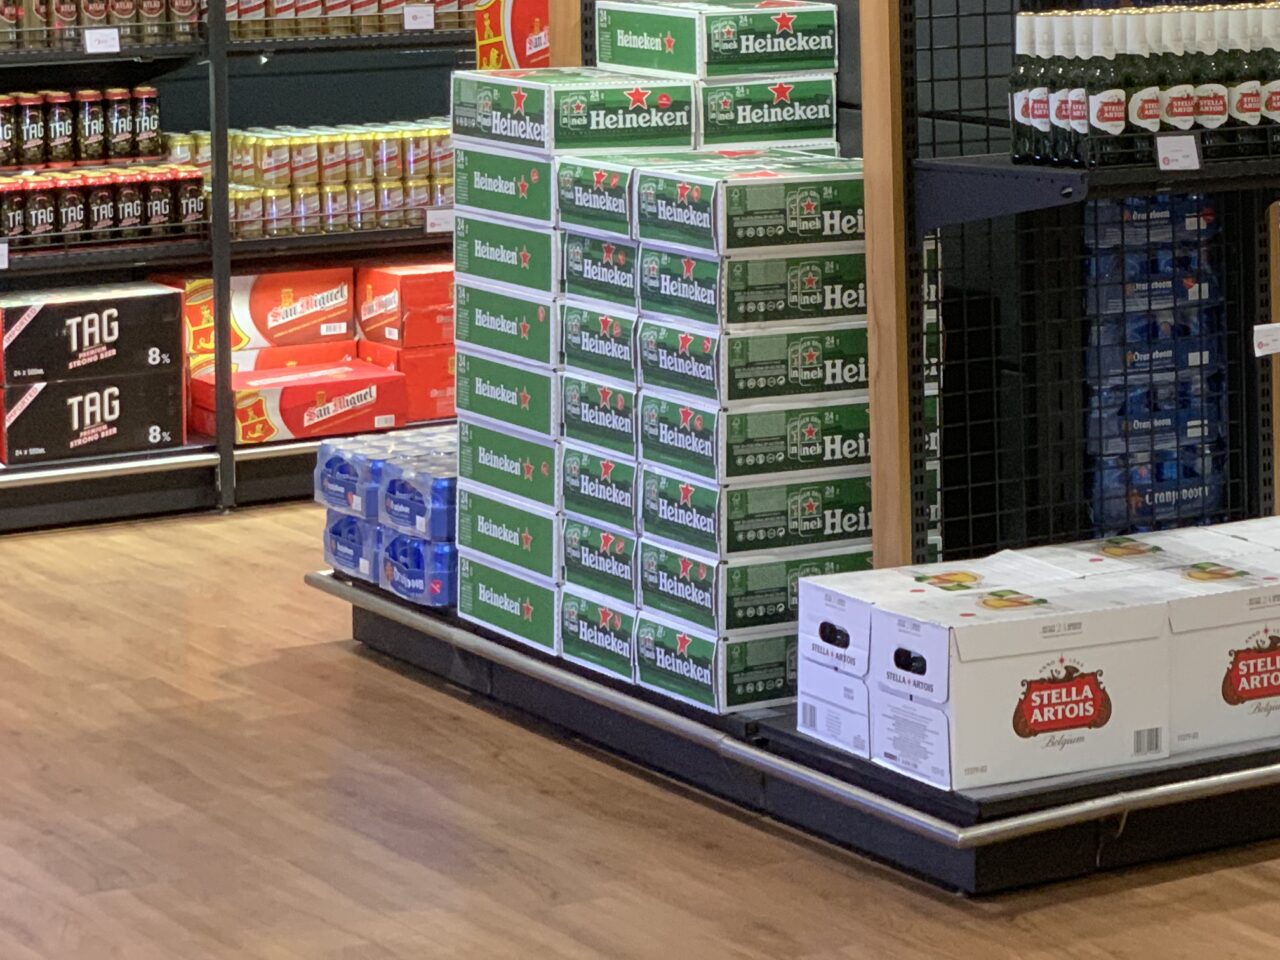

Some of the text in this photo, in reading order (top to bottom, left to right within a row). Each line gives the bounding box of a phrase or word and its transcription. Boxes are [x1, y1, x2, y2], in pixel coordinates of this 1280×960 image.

[616, 29, 663, 51] Heineken
[739, 29, 834, 54] Heineken
[111, 115, 133, 135] TAG
[135, 114, 159, 134] TAG
[589, 106, 691, 131] Heineken
[736, 100, 831, 125] Heineken
[22, 121, 44, 141] TAG
[50, 119, 73, 139] TAG
[84, 117, 105, 137] TAG
[474, 171, 516, 196] Heineken
[92, 201, 114, 222] TAG
[118, 199, 142, 219] TAG
[147, 198, 170, 218] TAG
[181, 196, 204, 216] TAG
[574, 186, 626, 214] Heineken
[8, 209, 24, 228] TA
[30, 206, 54, 226] TAG
[61, 204, 85, 224] TAG
[657, 199, 712, 229] Heineken
[474, 239, 518, 266] Heineken
[582, 258, 635, 289] Heineken
[660, 273, 716, 306] Heineken
[5, 305, 38, 344] IMPORTED
[65, 307, 120, 353] TAG
[475, 308, 518, 336] Heineken
[147, 346, 171, 366] 8%
[581, 330, 632, 362] Heineken
[68, 348, 117, 370] STRONG BEER
[658, 348, 714, 382] Heineken
[475, 376, 519, 406] Heineken
[7, 386, 39, 423] IMPORTED
[67, 386, 121, 431] TAG
[580, 401, 633, 435] Heineken
[69, 427, 118, 449] STRONG BEER
[148, 425, 172, 444] 8%
[658, 422, 714, 457] Heineken
[478, 446, 522, 476] Heineken
[580, 474, 632, 509] Heineken
[658, 498, 715, 535] Heineken
[477, 515, 520, 547] Heineken
[581, 545, 632, 581] Heineken
[478, 584, 521, 617] Heineken
[658, 570, 713, 610] Heineken
[579, 619, 631, 659] Heineken
[655, 647, 712, 686] Heineken
[811, 642, 857, 667] STELLA ARTOIS
[886, 670, 934, 693] STELLA ARTOIS
[1030, 684, 1094, 707] STELLA
[1030, 700, 1095, 724] ARTOIS
[1041, 734, 1086, 751] Belgium
